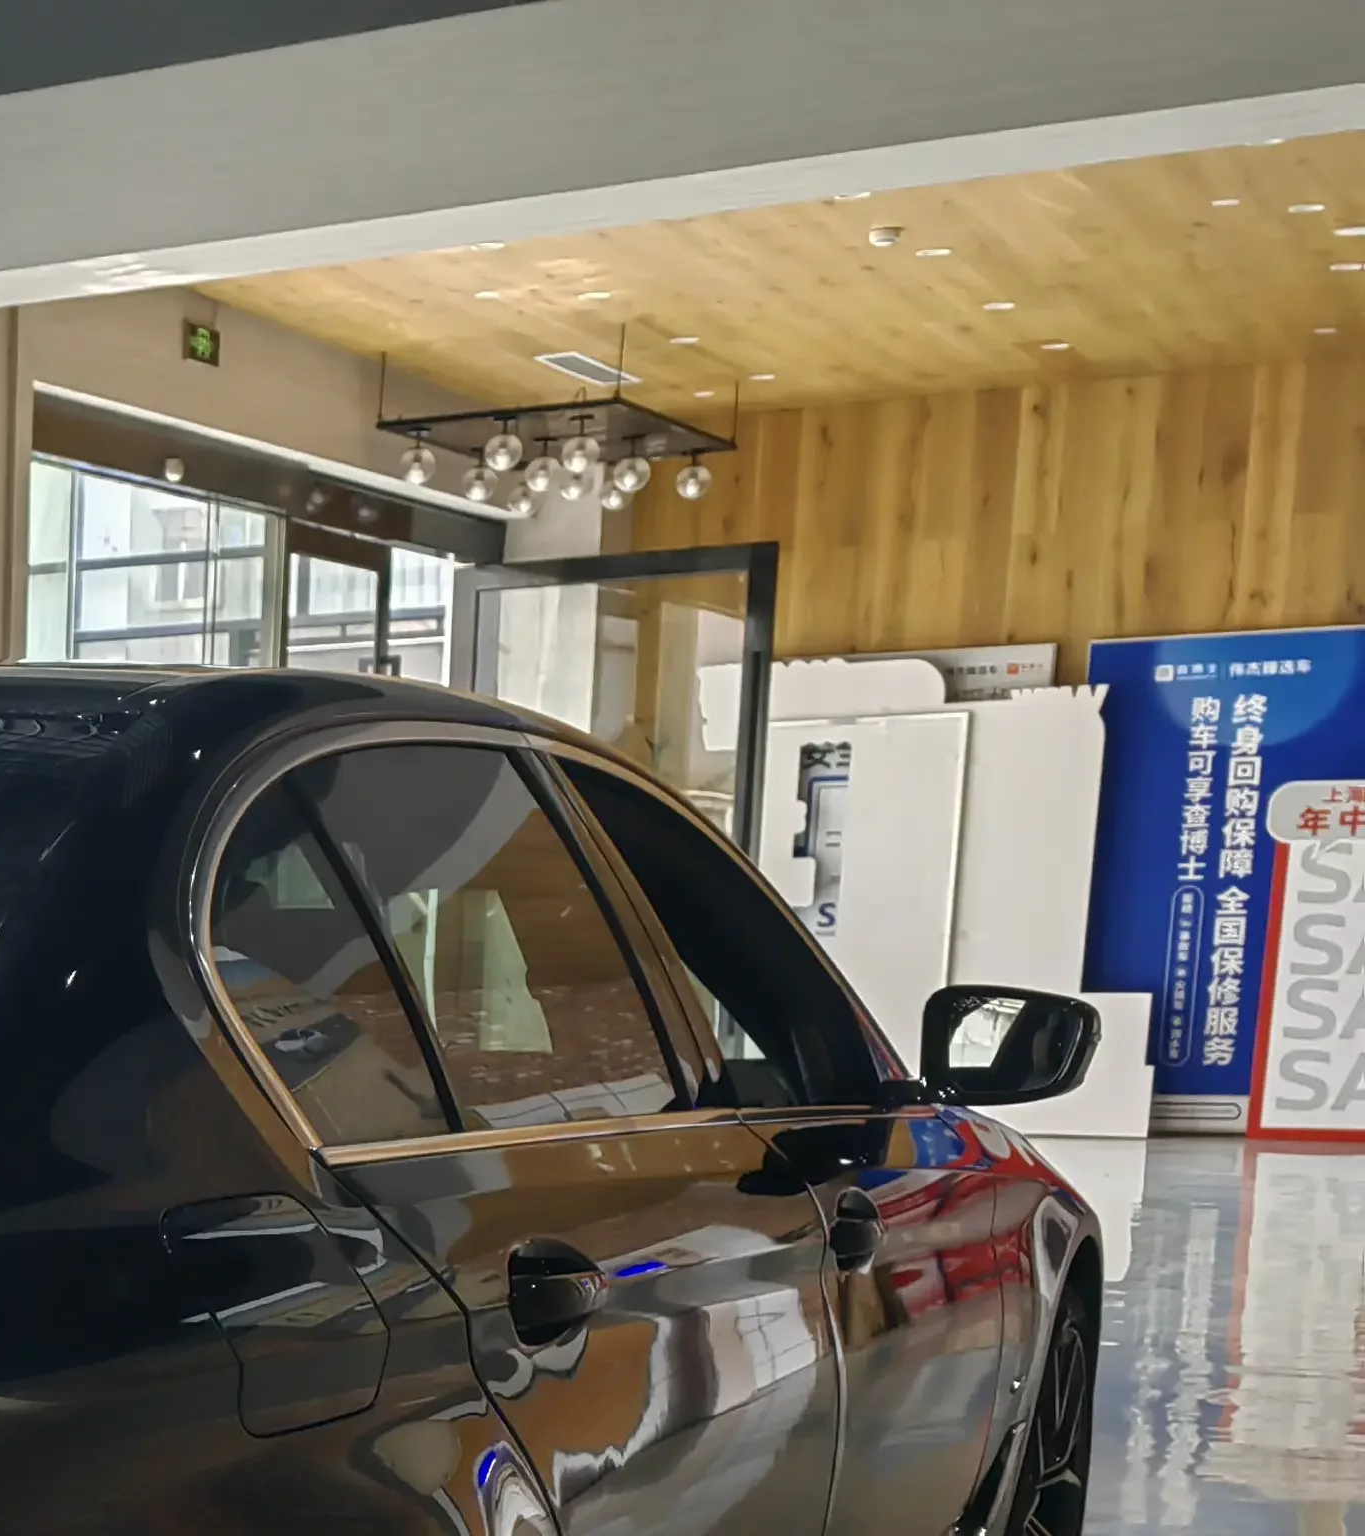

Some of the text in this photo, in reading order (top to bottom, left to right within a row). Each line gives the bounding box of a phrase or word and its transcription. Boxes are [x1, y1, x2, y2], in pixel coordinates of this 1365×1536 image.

[1177, 695, 1221, 882] 购车可享查博士
[1202, 693, 1268, 1067] 终身回购保障 全国保修服务
[1289, 912, 1365, 976] S
